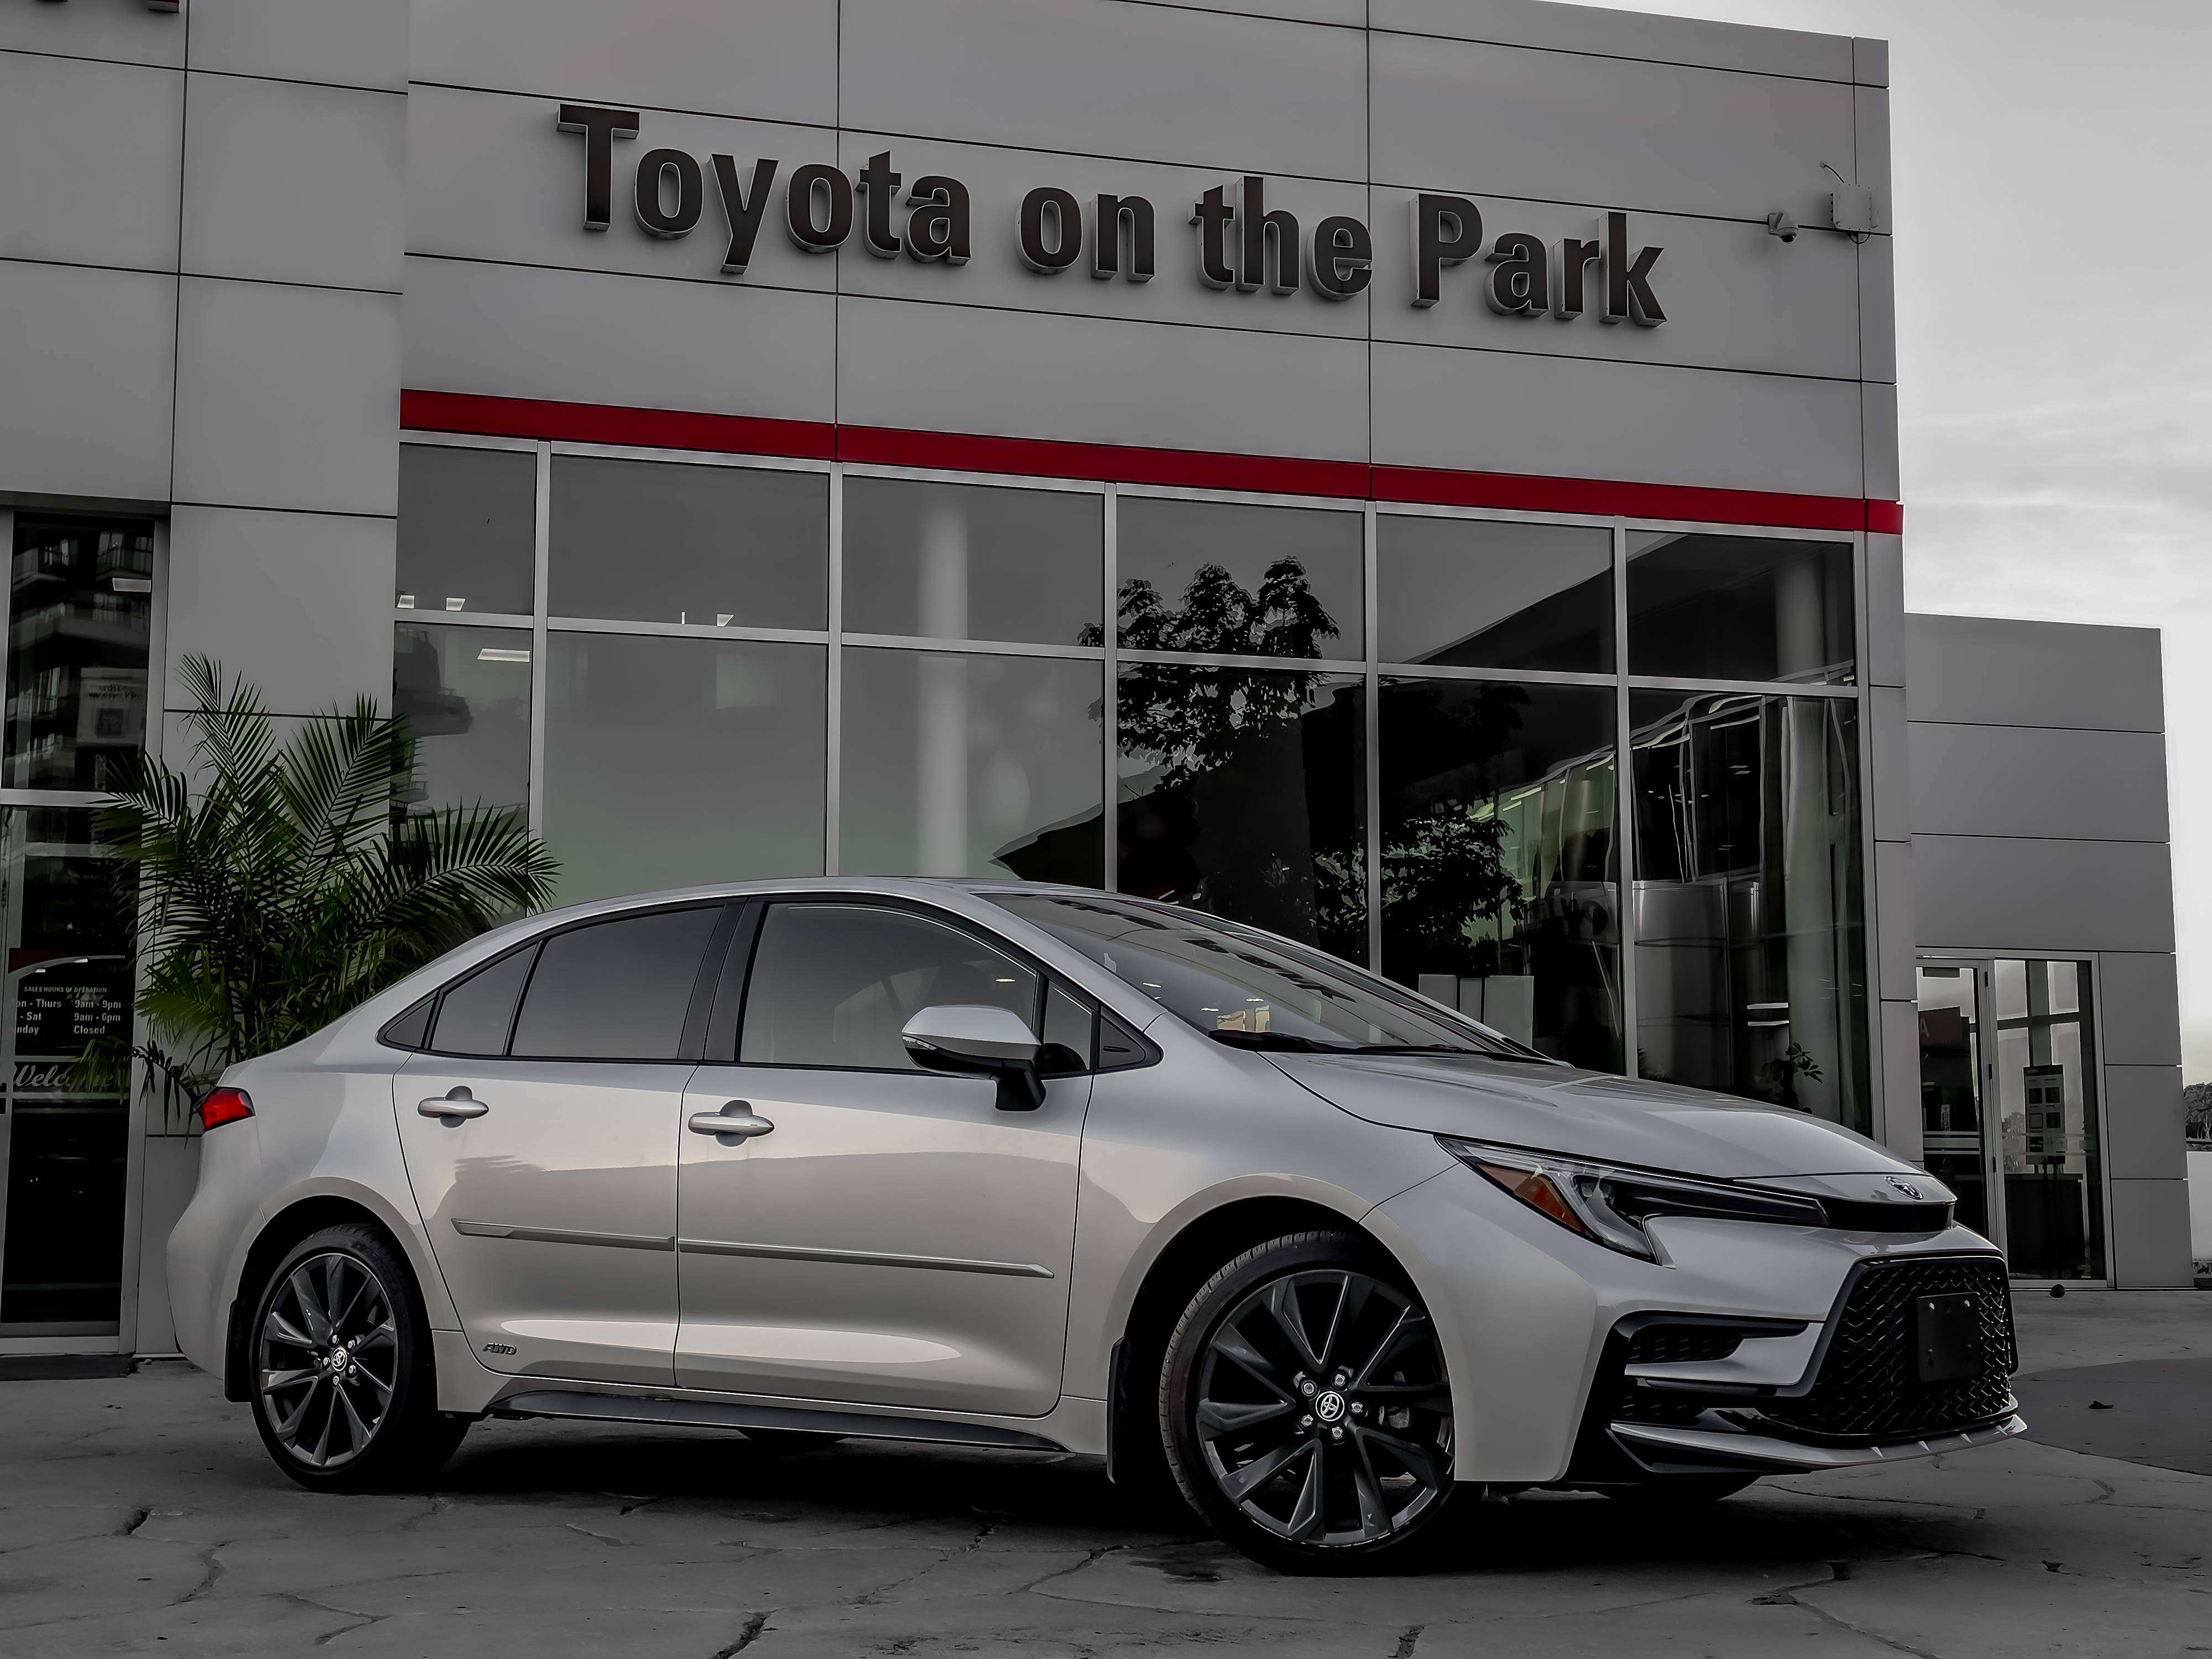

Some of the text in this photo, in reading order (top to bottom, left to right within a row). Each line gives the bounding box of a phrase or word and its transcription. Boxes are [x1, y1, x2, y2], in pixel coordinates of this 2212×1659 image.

[556, 103, 1667, 328] Toyota on the Park
[35, 998, 61, 1008] Thurs
[75, 999, 93, 1008] 9am
[102, 999, 121, 1011] 9pm
[26, 1011, 41, 1021] Sat
[74, 1012, 93, 1021] 9am
[102, 1012, 121, 1024] 6pm
[16, 1025, 105, 1036] nday Closed
